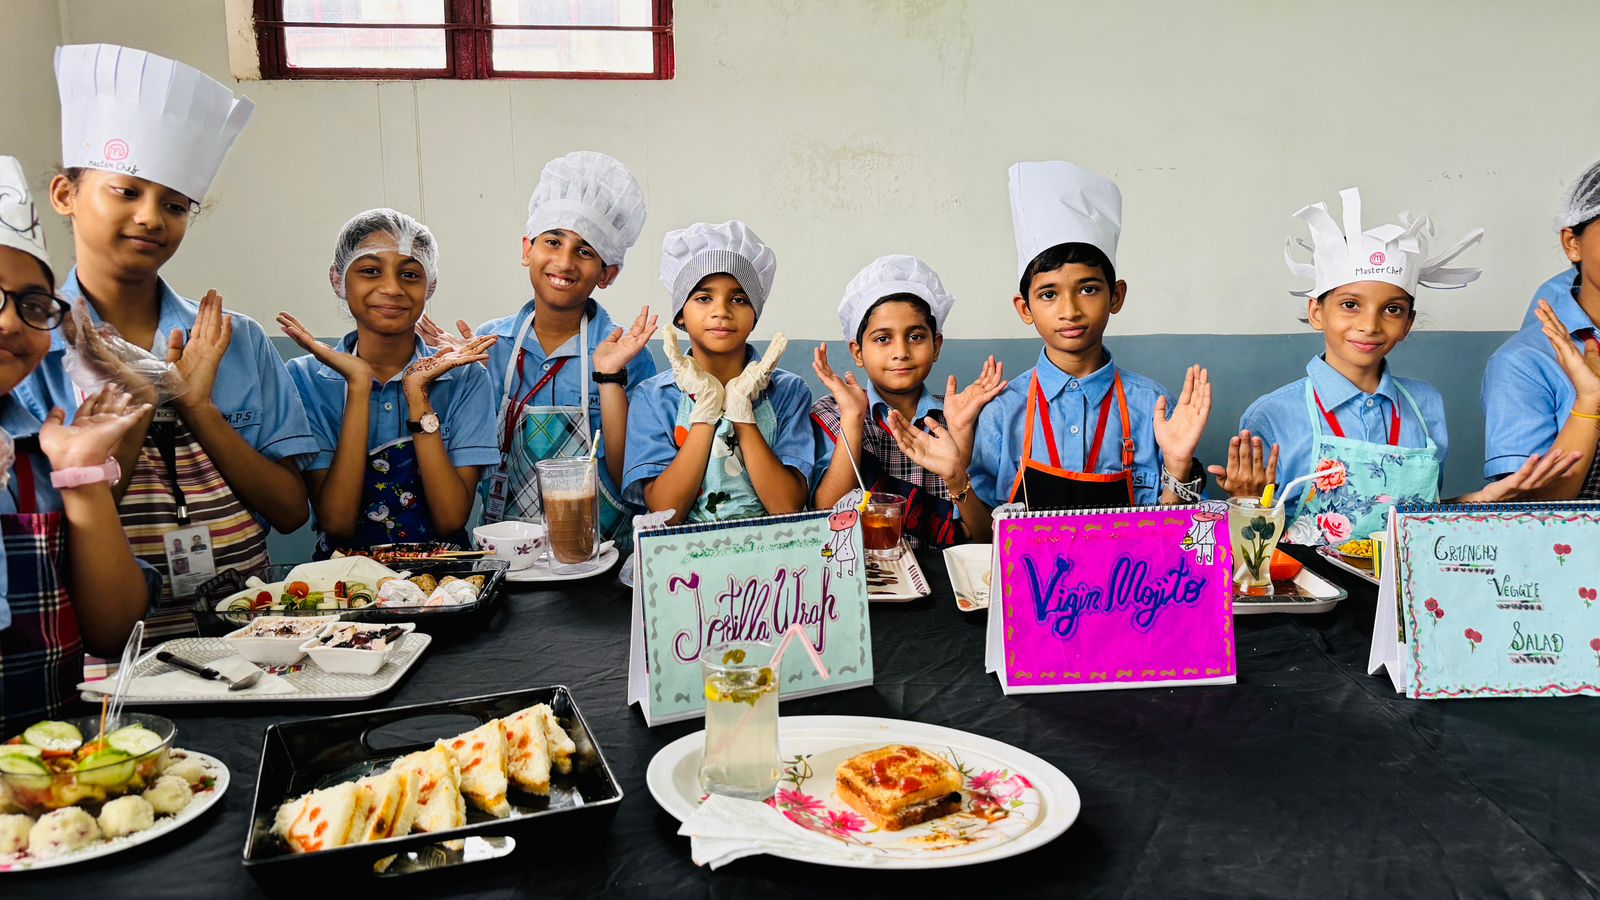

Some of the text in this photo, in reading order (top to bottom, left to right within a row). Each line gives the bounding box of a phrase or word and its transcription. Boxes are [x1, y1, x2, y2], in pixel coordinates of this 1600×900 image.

[1433, 535, 1498, 562] CRUNCHY
[669, 566, 838, 662] Tortilla Wrap
[1104, 556, 1207, 628] Mojito
[1508, 620, 1564, 653] SALAD
